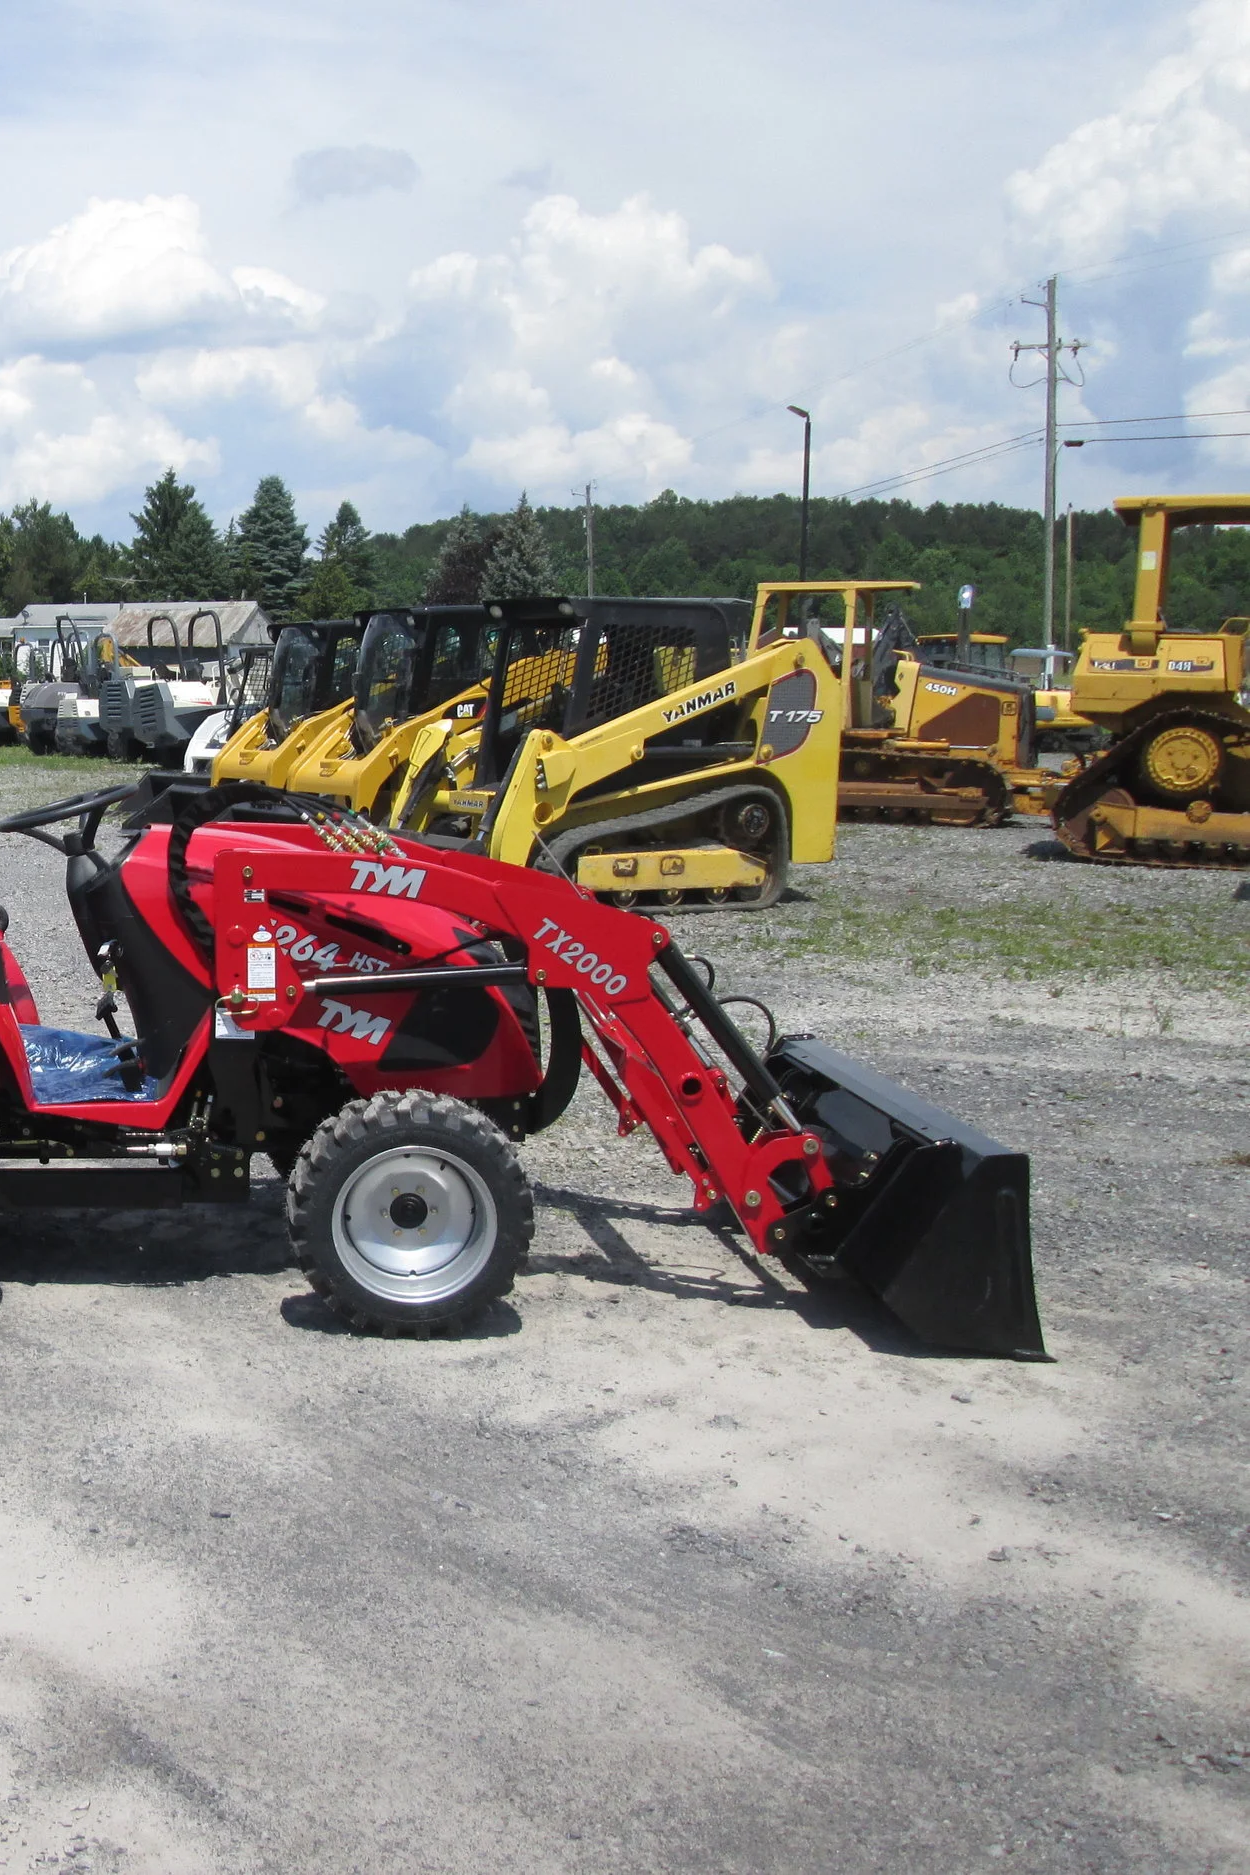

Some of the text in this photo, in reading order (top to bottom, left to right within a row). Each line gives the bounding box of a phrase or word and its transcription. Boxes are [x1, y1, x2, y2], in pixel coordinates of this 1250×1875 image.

[662, 681, 736, 724] YANMAR
[925, 683, 958, 696] 450H
[456, 704, 475, 717] CAT
[453, 798, 484, 809] YANMAR
[350, 859, 427, 899] TYM
[270, 918, 391, 973] 264 HST
[532, 917, 627, 995] TX2000
[316, 998, 392, 1046] TYM
